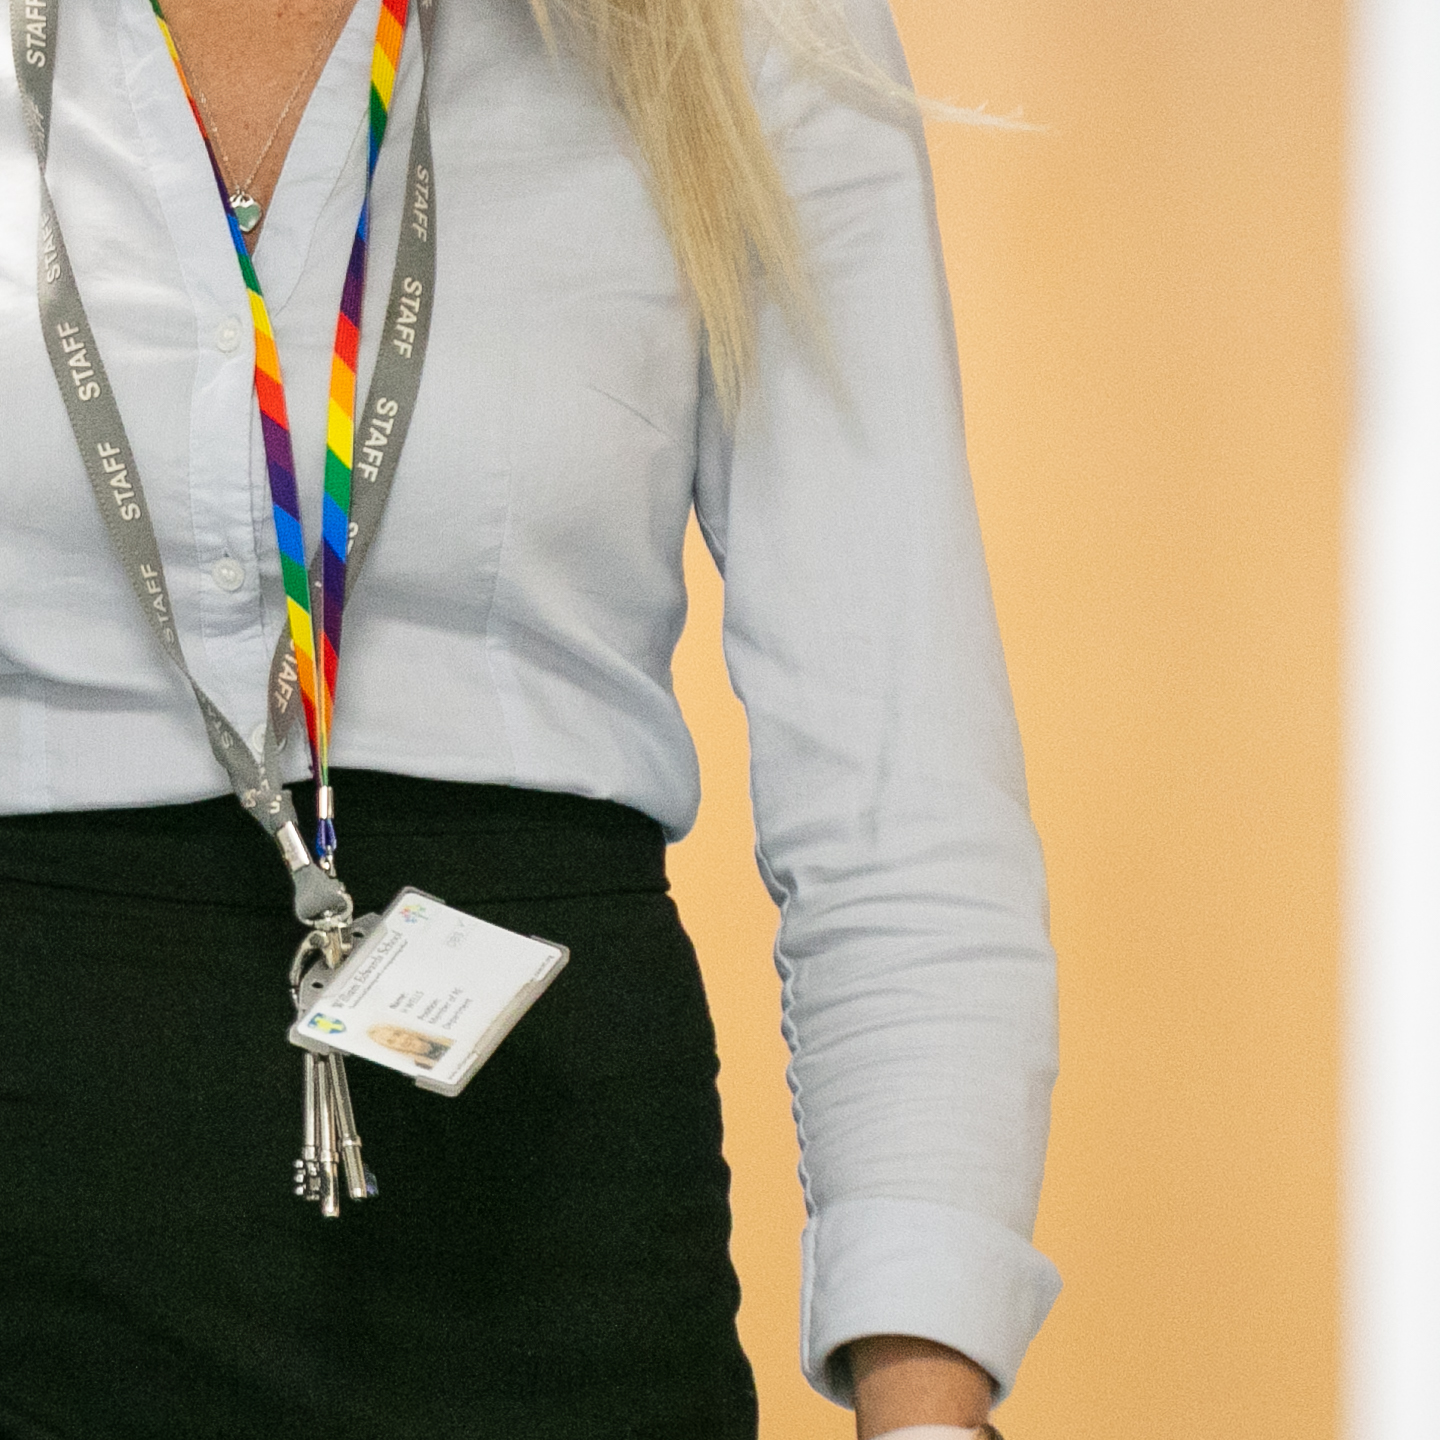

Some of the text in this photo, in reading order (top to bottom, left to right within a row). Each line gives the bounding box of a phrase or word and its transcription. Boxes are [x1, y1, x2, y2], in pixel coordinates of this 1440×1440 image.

[413, 164, 430, 242] STAFF
[41, 213, 61, 283] STAFF
[392, 276, 423, 359] STAFF
[56, 320, 101, 402] STAFF
[358, 396, 398, 483] STAFF
[97, 441, 142, 521] STAFF
[140, 563, 175, 643] STAFF
